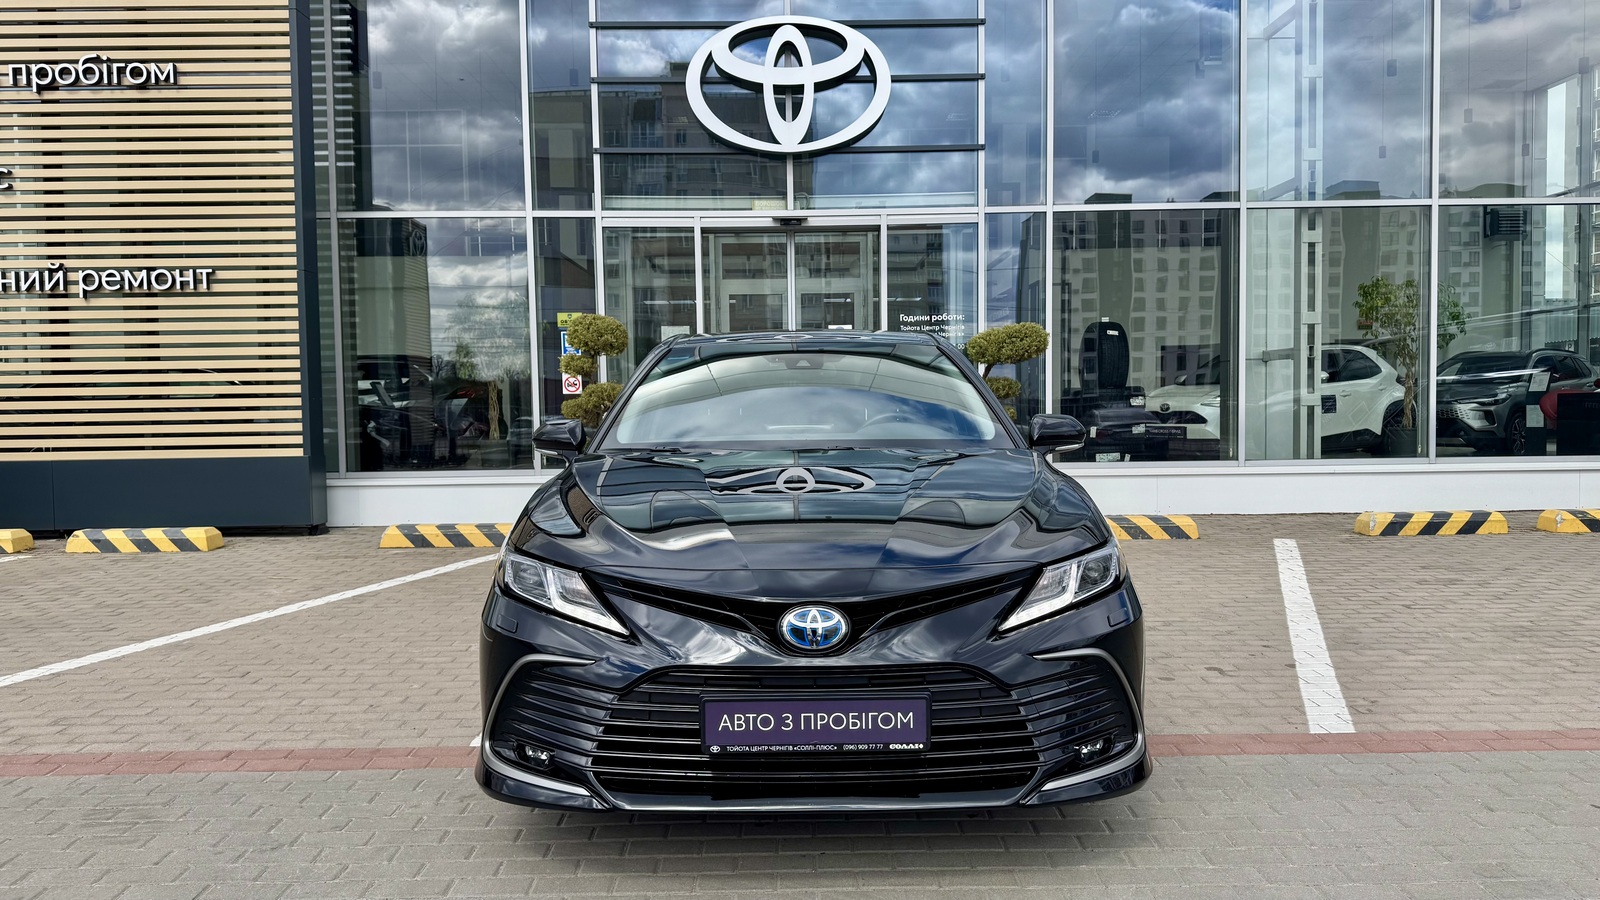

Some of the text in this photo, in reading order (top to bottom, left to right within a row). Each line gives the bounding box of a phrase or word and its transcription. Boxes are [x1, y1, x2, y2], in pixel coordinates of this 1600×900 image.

[8, 53, 177, 94] пробігом
[78, 268, 214, 299] ремонт
[899, 312, 965, 322] Години роботи:
[718, 712, 914, 731] АВТО З ПРОБІГОМ
